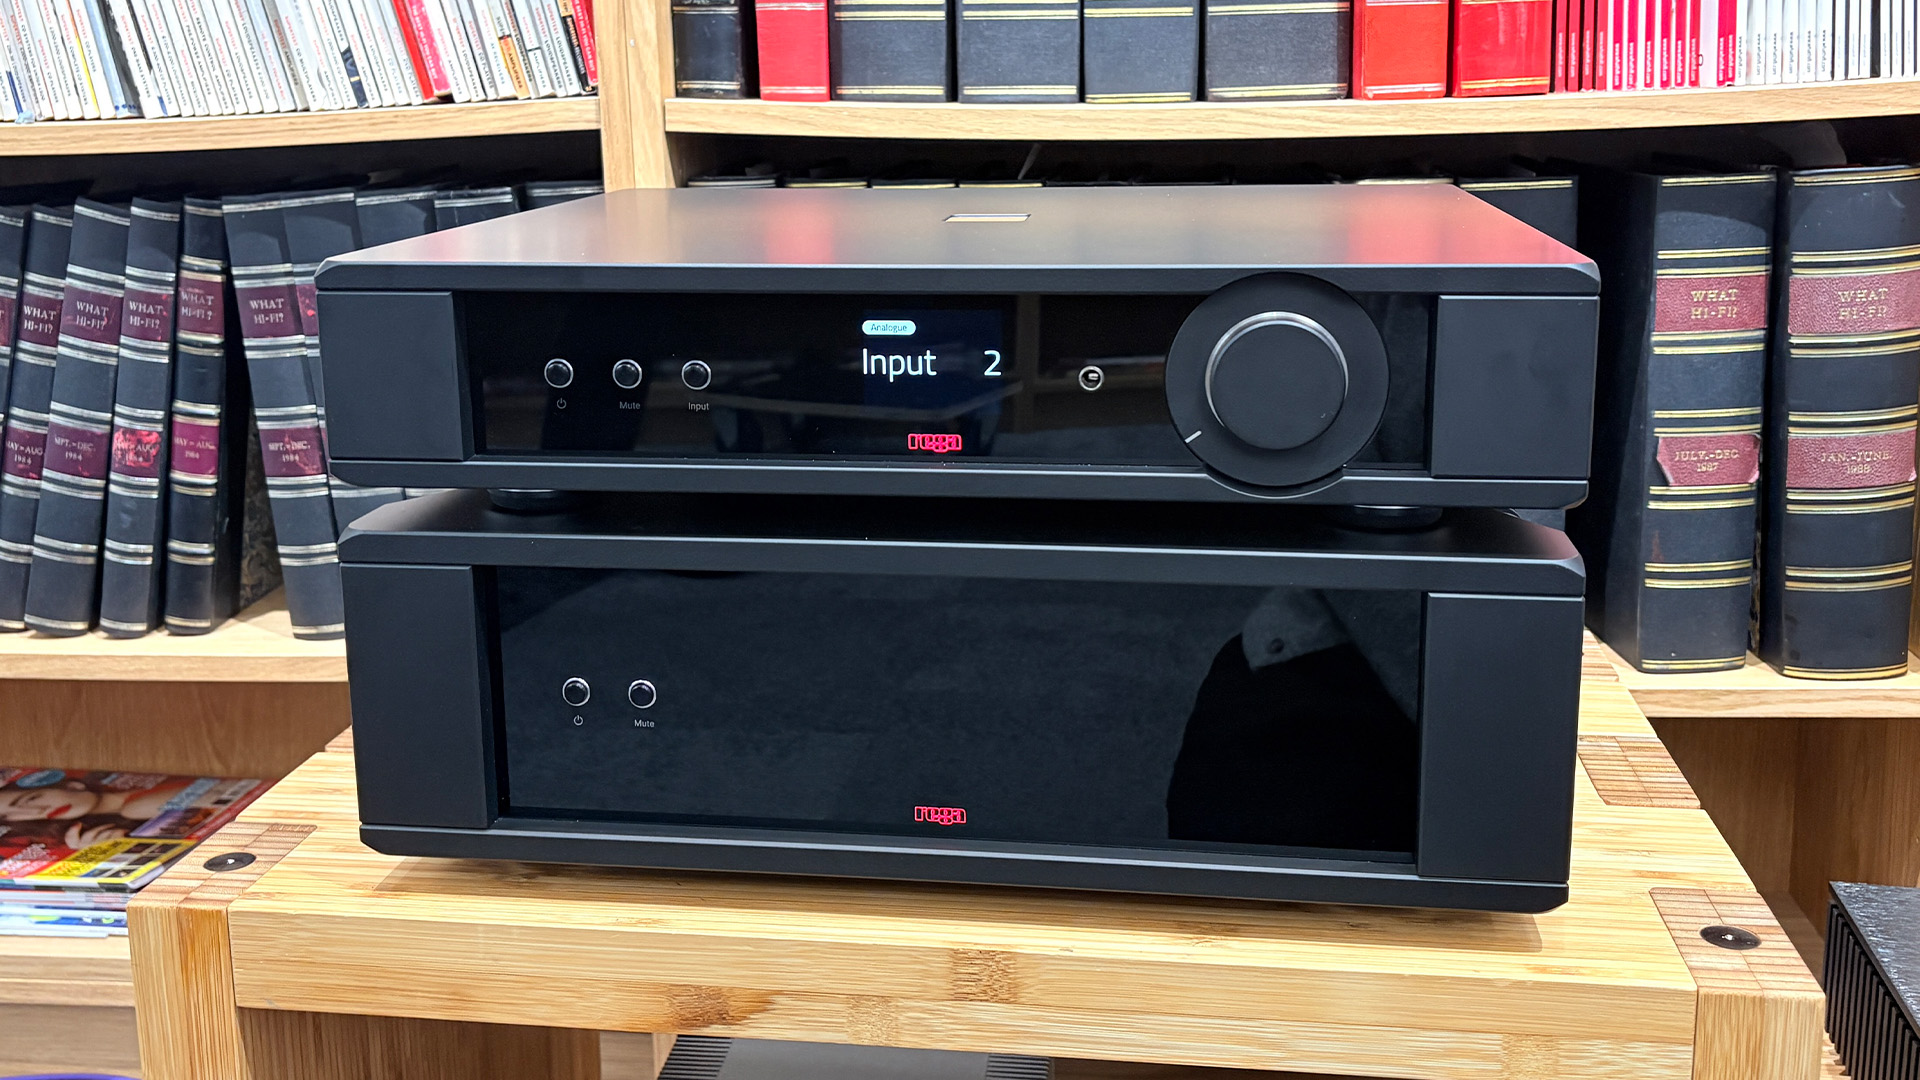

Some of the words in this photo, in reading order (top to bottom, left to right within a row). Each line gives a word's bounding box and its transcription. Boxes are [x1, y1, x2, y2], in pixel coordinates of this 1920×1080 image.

[544, 39, 562, 88] LOUDSPEAKERS
[555, 36, 573, 85] LOUDSPEAKERS
[180, 291, 214, 306] WHAT
[1690, 288, 1738, 302] WHAT
[1837, 287, 1888, 302] WHAT
[76, 300, 109, 317] WHAT
[129, 301, 163, 315] WHAT
[250, 298, 284, 310] WHAT
[24, 305, 56, 320] WHAT
[1690, 306, 1737, 319] HI-FI?
[1838, 305, 1887, 320] HI-FI?
[870, 323, 907, 333] Analogue
[863, 348, 937, 383] Input
[984, 350, 1002, 376] 2
[619, 401, 641, 410] Mute
[688, 402, 709, 412] Input
[908, 433, 962, 453] rega
[1696, 462, 1719, 472] 1987
[634, 719, 655, 728] Mute
[914, 806, 967, 825] rega
